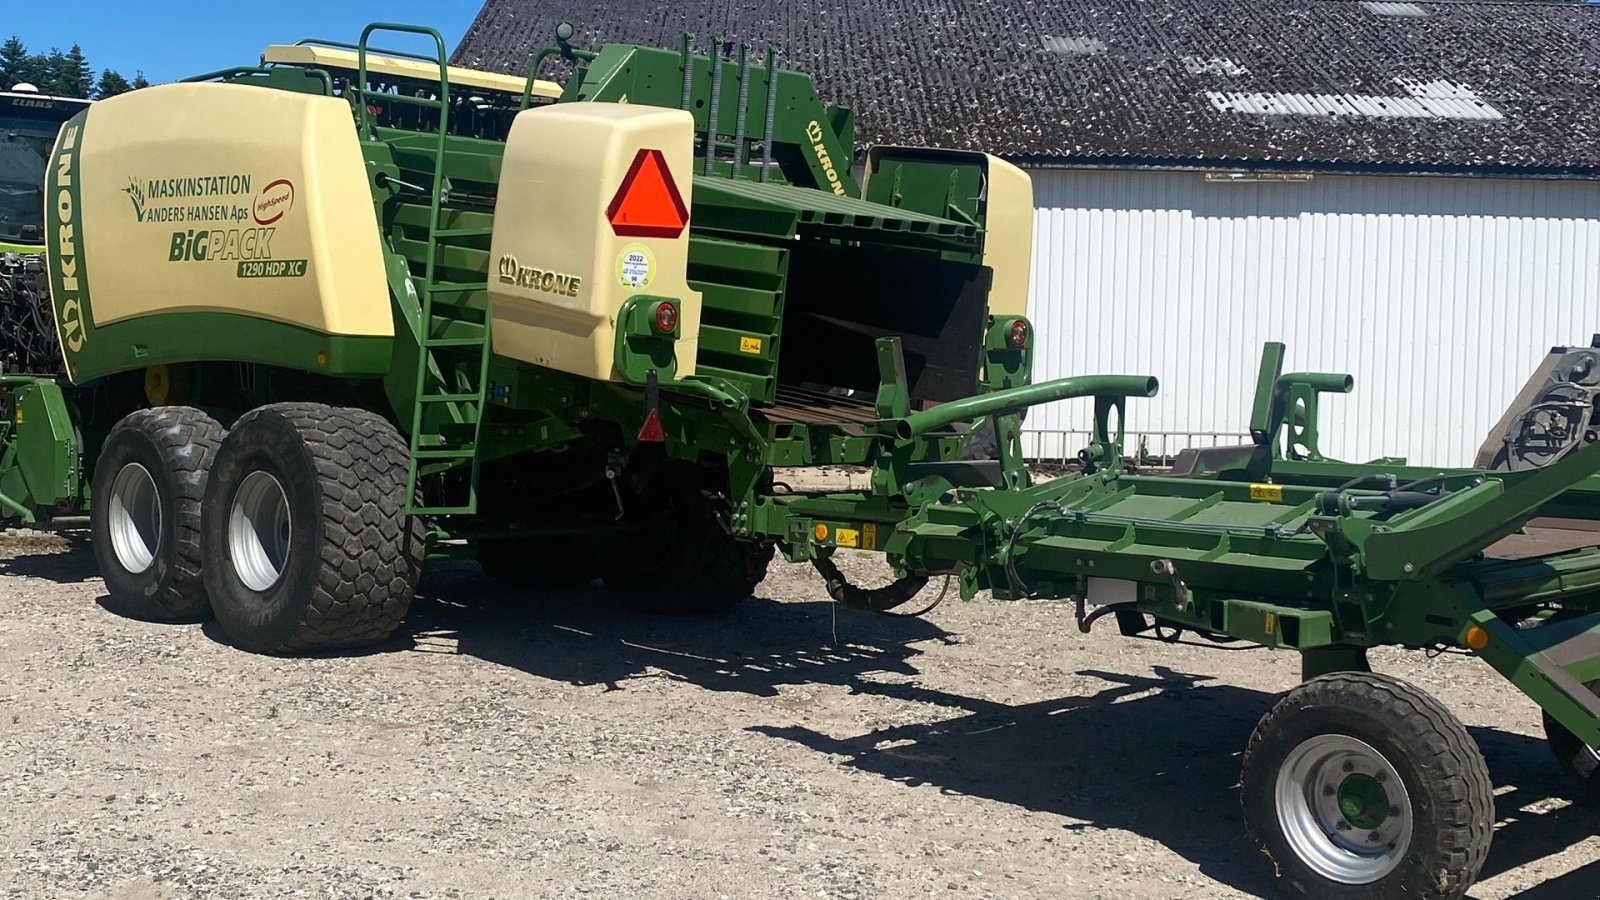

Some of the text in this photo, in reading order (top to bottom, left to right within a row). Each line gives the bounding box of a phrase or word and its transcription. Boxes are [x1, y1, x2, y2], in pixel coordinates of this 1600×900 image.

[12, 98, 53, 109] CLAAS
[814, 143, 847, 197] KRON
[148, 174, 251, 199] MASKINSTATION
[57, 125, 79, 291] KRONE
[257, 192, 290, 211] HighSpeed
[147, 204, 249, 223] ANDERS HANSEN Aps
[168, 227, 276, 262] BiGPACK
[241, 261, 303, 277] 1290 HDP XC
[629, 254, 644, 262] 2022
[516, 266, 582, 297] KRONE
